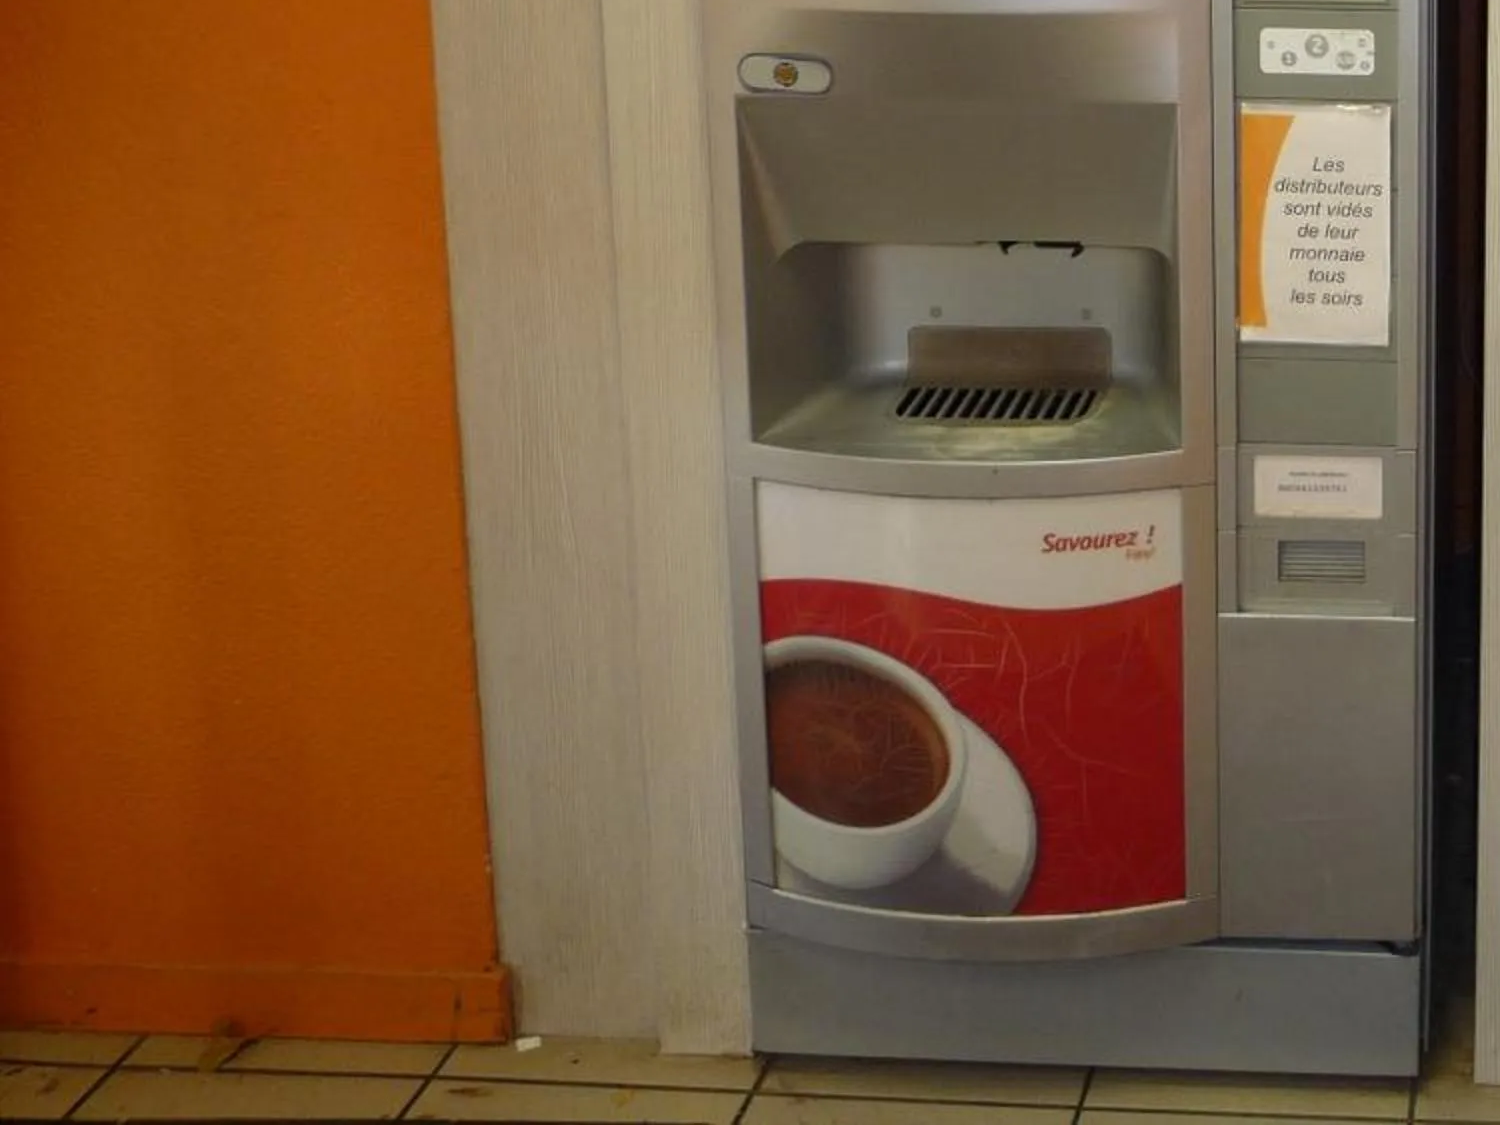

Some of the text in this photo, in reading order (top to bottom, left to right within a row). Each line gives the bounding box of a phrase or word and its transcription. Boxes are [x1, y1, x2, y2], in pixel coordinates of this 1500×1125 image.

[1312, 157, 1345, 173] Les
[1274, 178, 1383, 196] distributeurs
[1283, 201, 1373, 218] sont vidés
[1297, 224, 1359, 240] de leur
[1289, 247, 1365, 263] monnaie
[1308, 269, 1346, 284] tous
[1290, 289, 1364, 306] les soirs
[1041, 530, 1139, 554] Savourez
